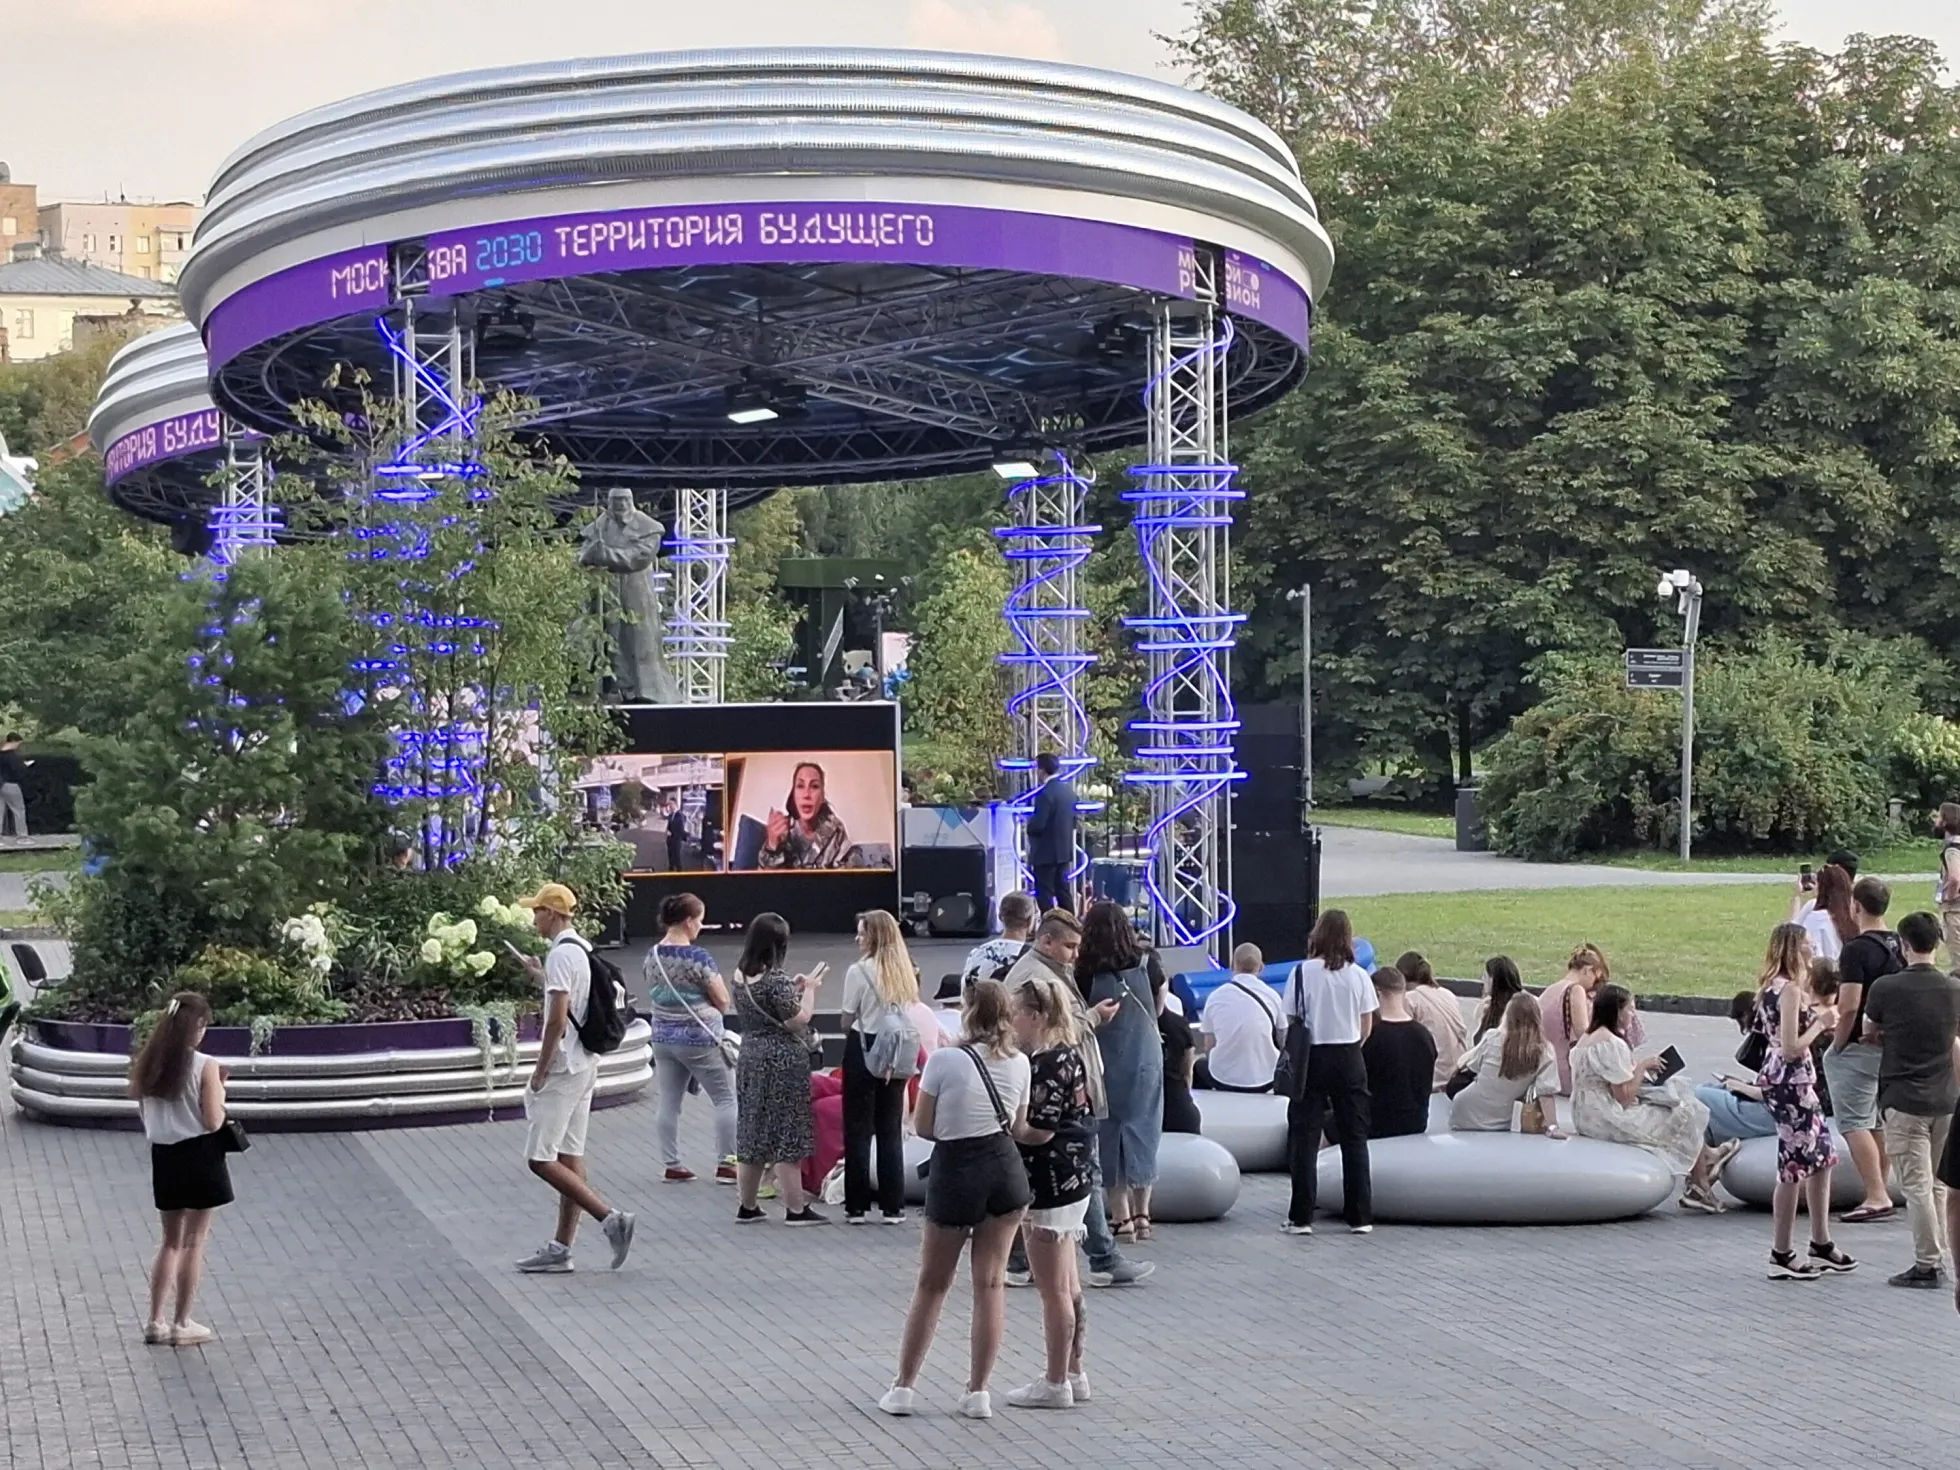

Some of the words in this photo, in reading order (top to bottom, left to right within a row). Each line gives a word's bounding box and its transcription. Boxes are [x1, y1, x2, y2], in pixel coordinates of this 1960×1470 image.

[476, 231, 543, 271] 2030
[554, 213, 743, 258] ТЕРРИТОРИЯ
[760, 213, 934, 248] БУДУЩЕГО
